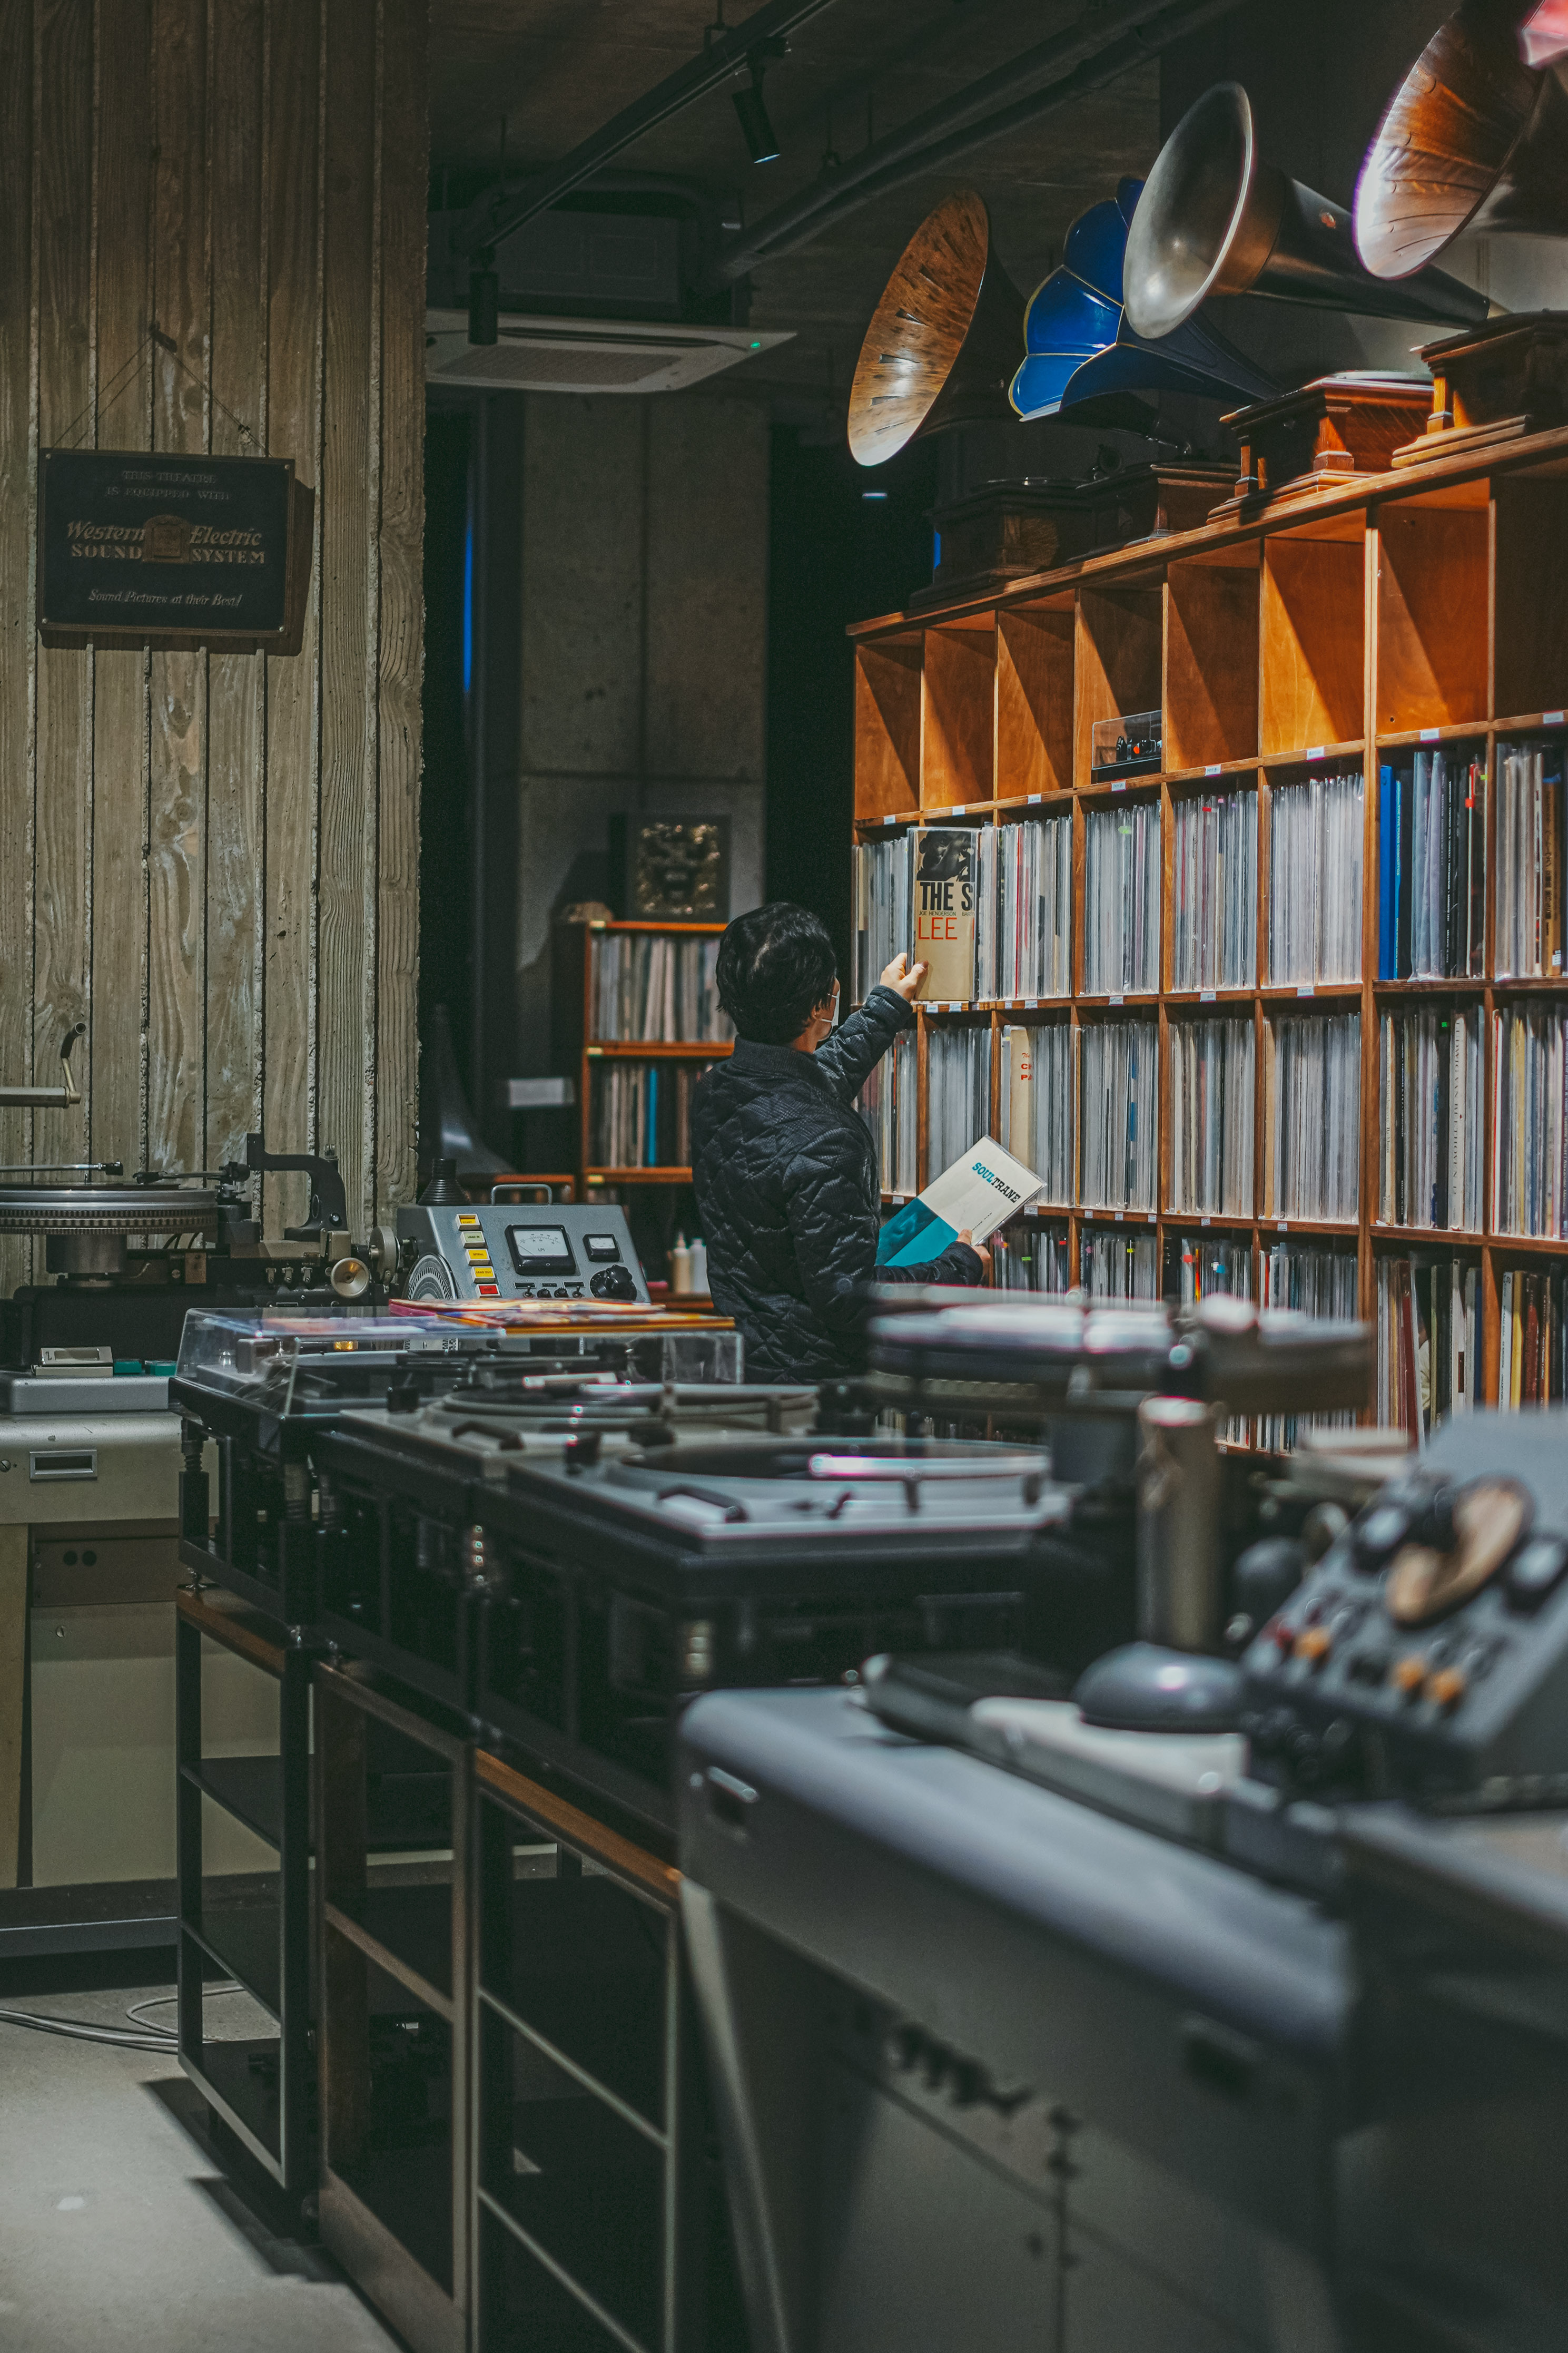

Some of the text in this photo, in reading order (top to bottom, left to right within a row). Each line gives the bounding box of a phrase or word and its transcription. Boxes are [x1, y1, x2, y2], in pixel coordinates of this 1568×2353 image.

[107, 486, 119, 495] IS
[198, 491, 229, 500] WITH
[67, 521, 262, 546] Western Electric
[72, 543, 264, 564] SOUND SYSTEM
[88, 589, 243, 606] Sound Pictures at their Best!
[920, 881, 975, 911] THE S
[918, 917, 957, 939] LEE
[972, 1162, 1021, 1203] SOULTRANE
